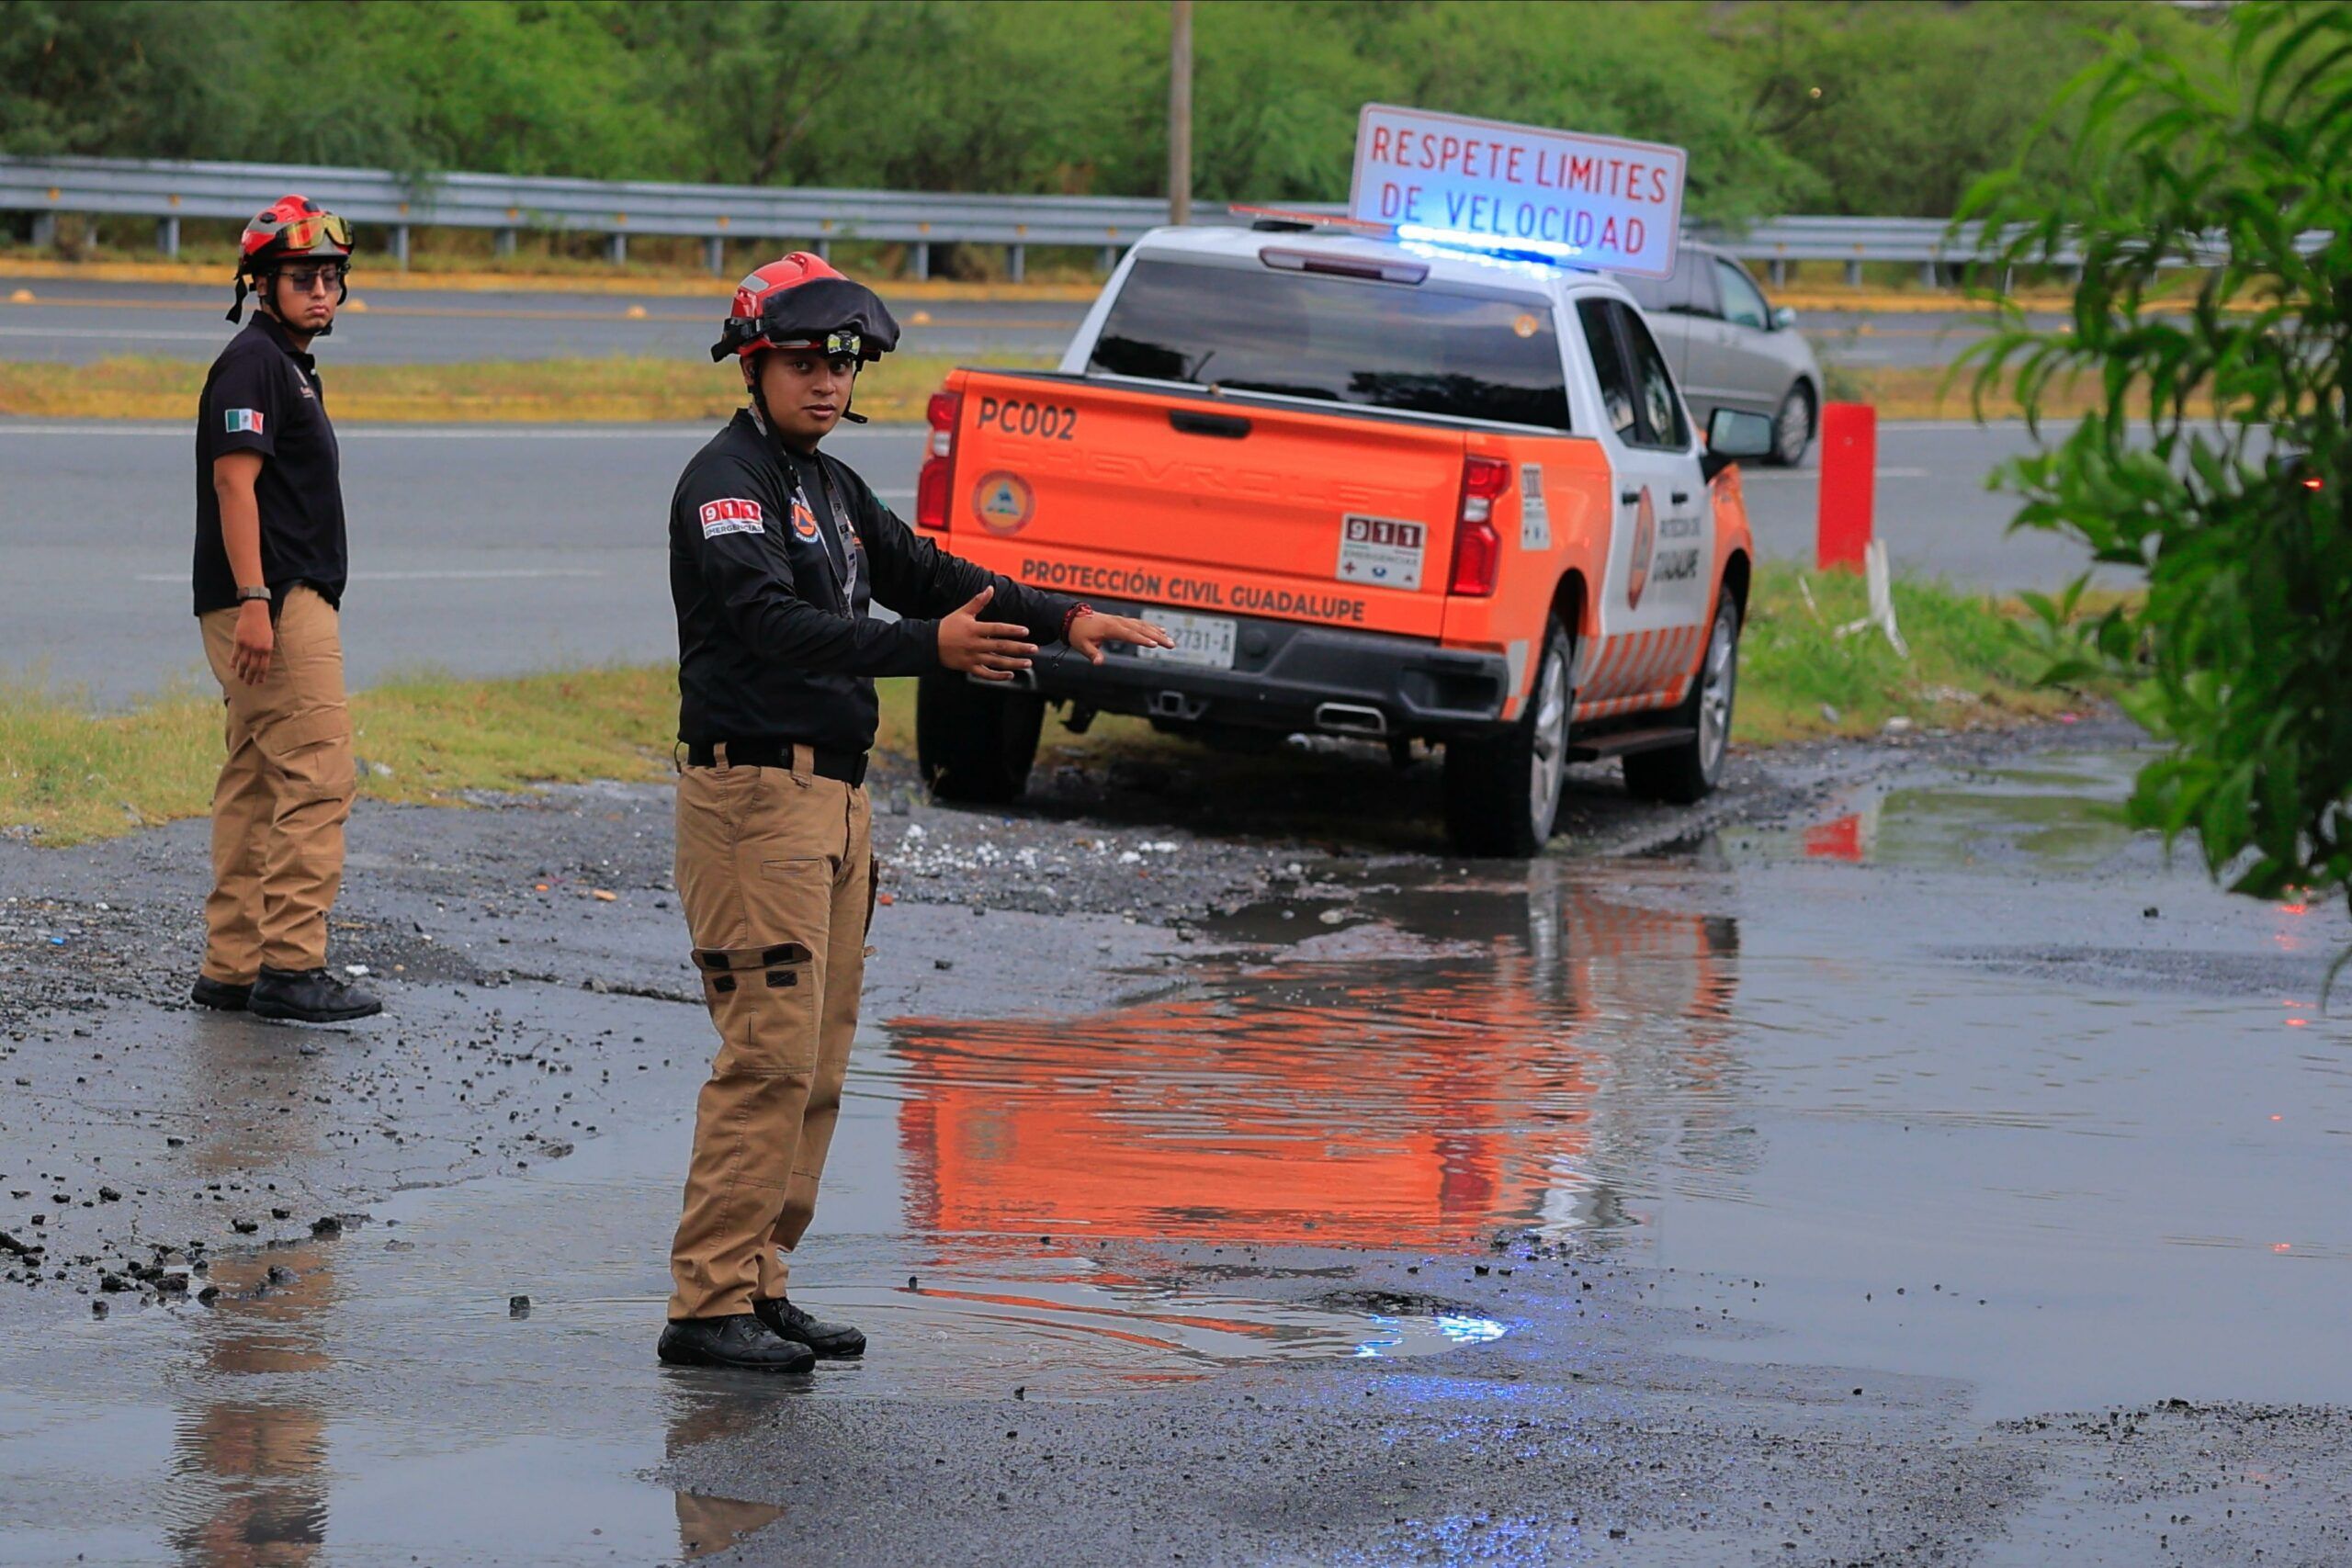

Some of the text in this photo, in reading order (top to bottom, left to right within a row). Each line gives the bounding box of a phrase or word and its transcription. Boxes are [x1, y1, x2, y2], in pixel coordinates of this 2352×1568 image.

[1371, 126, 1668, 204] RESPETE LIMITES
[1382, 182, 1645, 254] DE VELOCIDAD
[977, 396, 1078, 441] PC002
[704, 502, 757, 522] 911
[1349, 519, 1418, 547] 911
[1022, 558, 1366, 622] PROTECCIÓN CIVIL GUADALUPE
